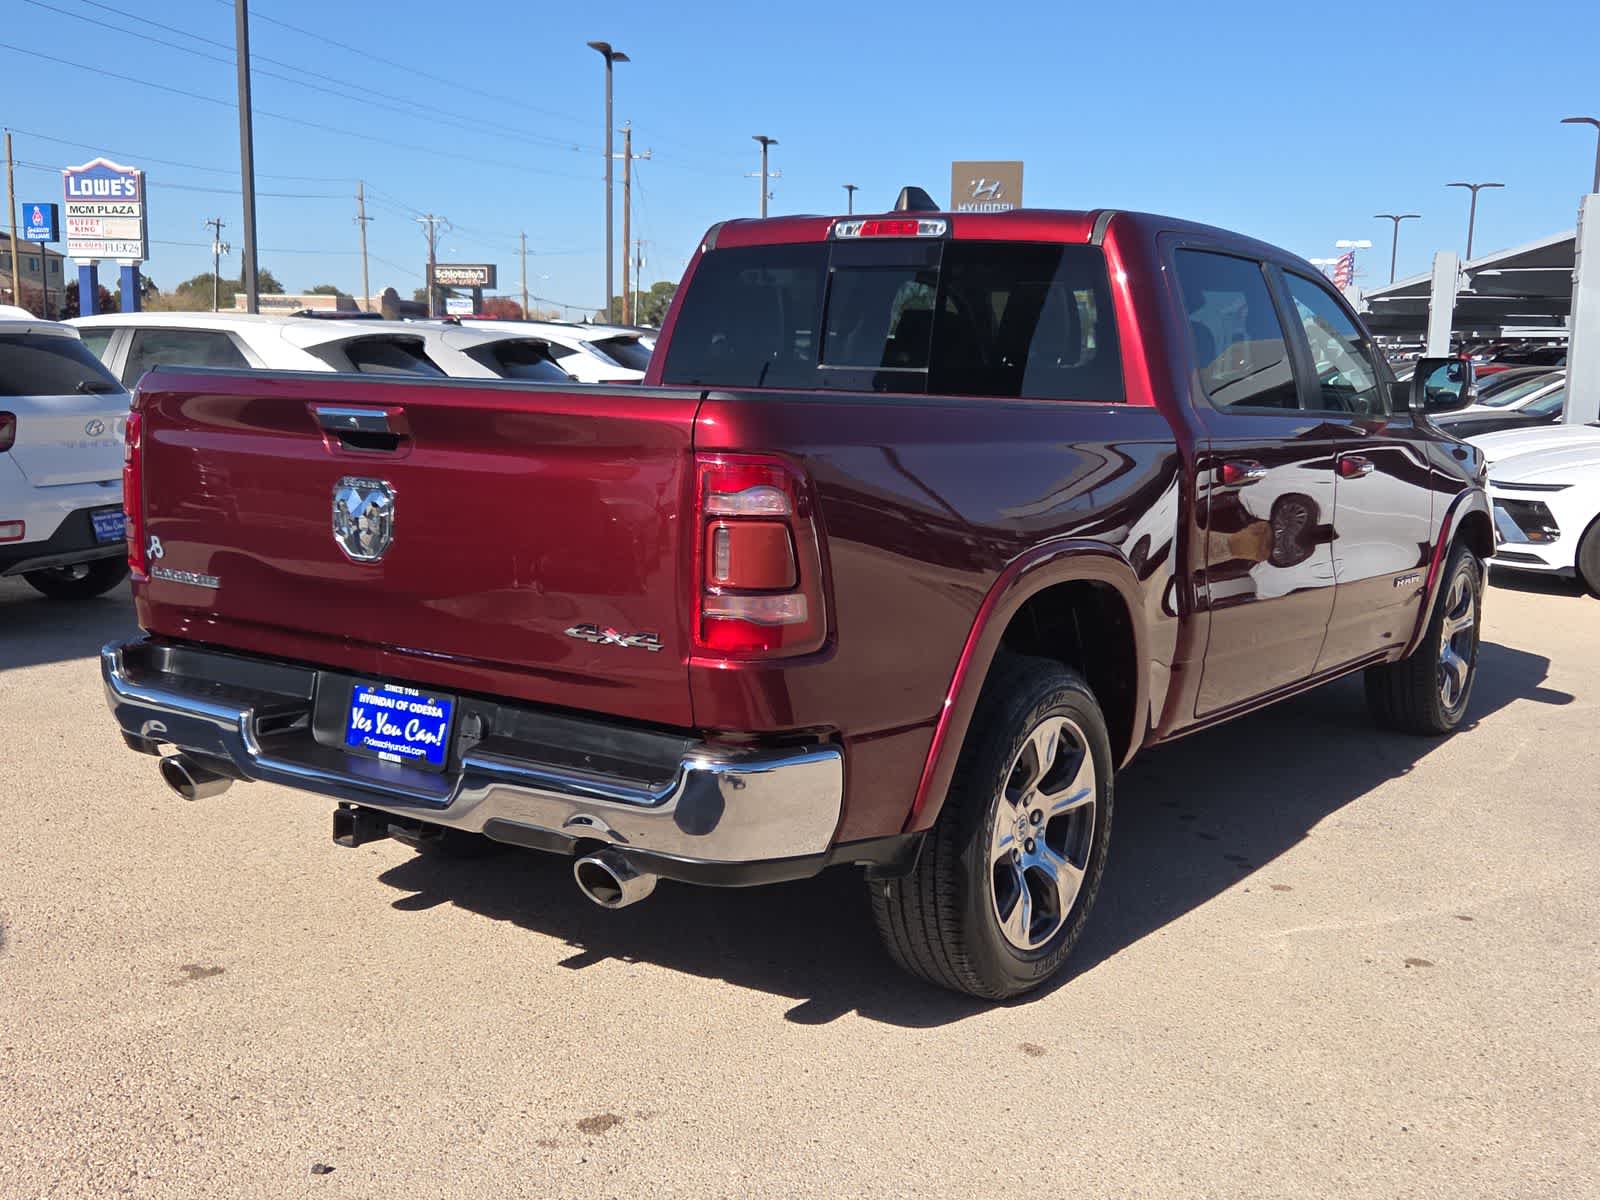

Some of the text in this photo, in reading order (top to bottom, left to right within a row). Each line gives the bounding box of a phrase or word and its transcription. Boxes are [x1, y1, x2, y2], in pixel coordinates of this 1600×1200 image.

[68, 176, 136, 196] LOWE'S
[69, 205, 134, 215] MCM PLAZA
[384, 684, 404, 694] SINCE
[359, 693, 443, 718] HYUNDAI OF ODESSA
[351, 707, 446, 746] Yes You Can!
